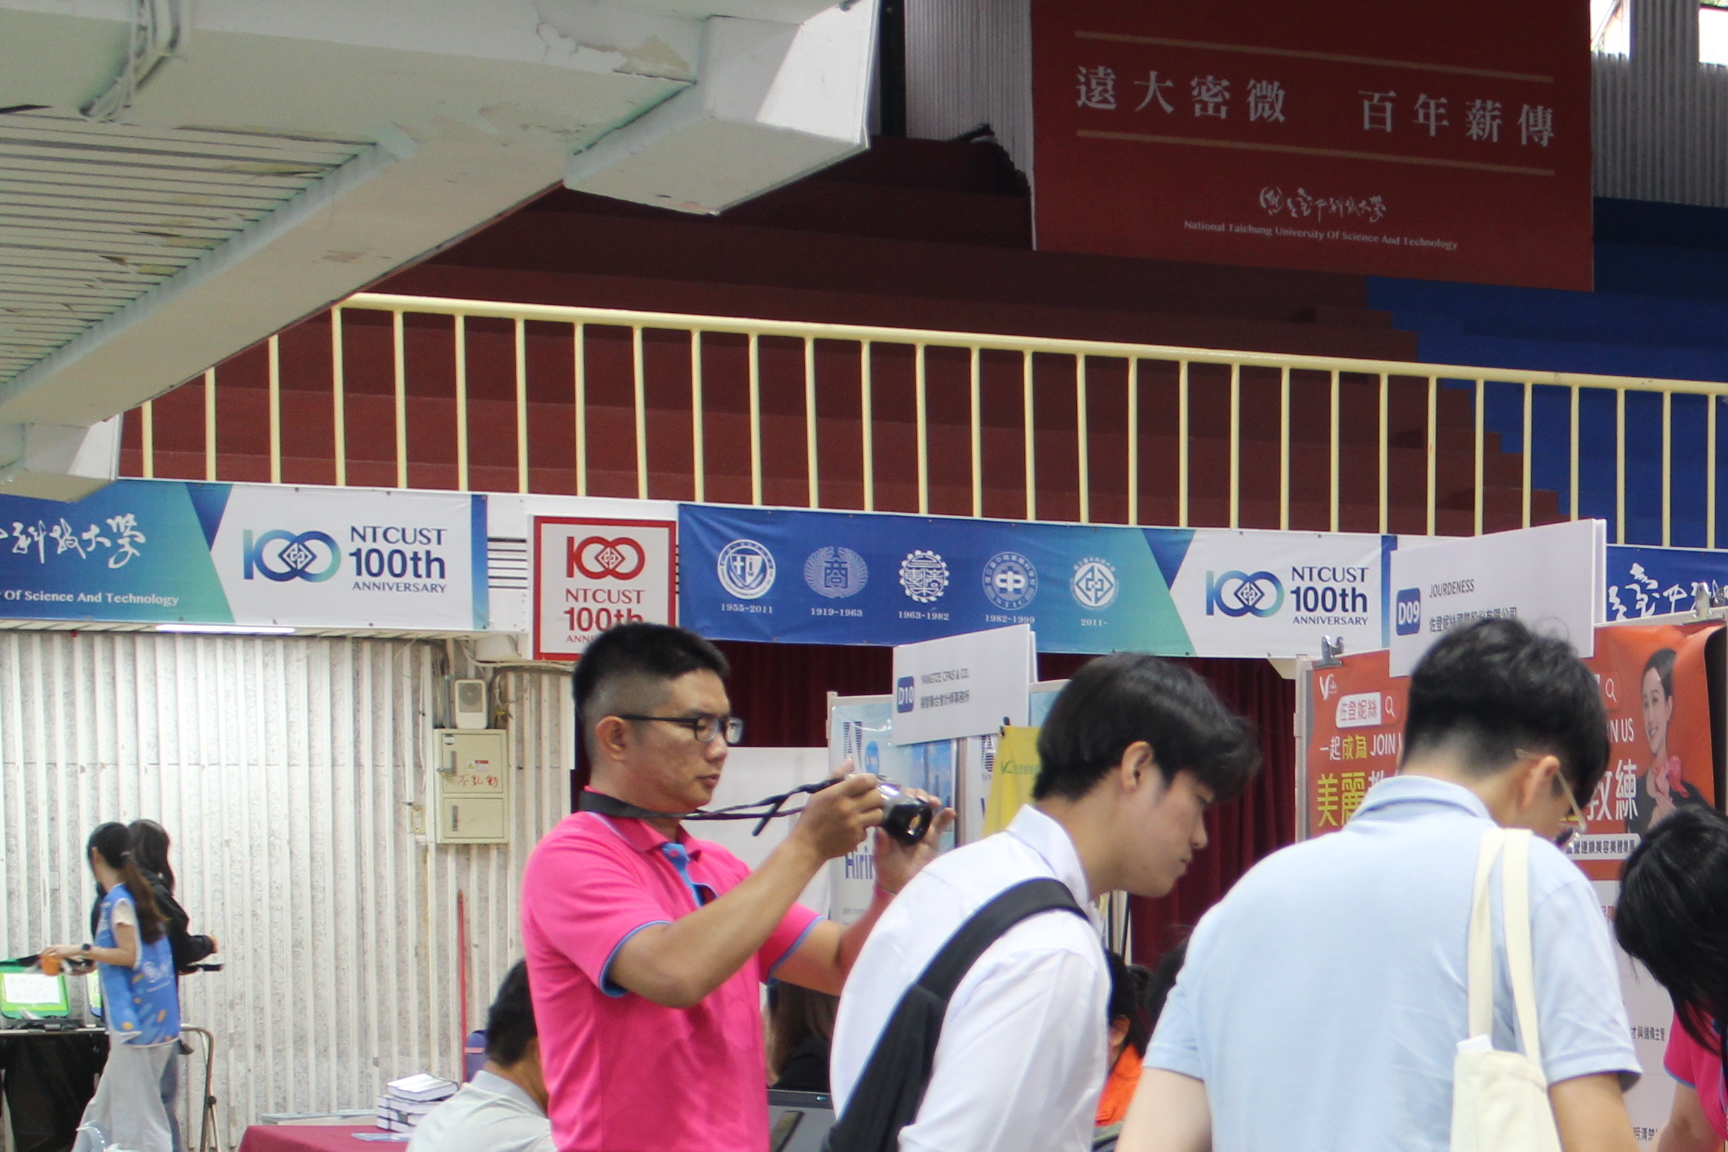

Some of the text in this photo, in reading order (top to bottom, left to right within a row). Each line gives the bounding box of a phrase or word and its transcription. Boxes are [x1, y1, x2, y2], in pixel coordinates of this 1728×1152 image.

[1075, 66, 1555, 147] 遠大密微 百年薪傳
[1184, 220, 1458, 250] National Taichung University Of Science And Technology
[350, 525, 447, 545] NTCUST
[348, 547, 445, 579] 100th
[1290, 565, 1370, 582] NTCUST
[352, 581, 447, 593] ANNIVERSARY
[565, 589, 645, 604] NTCUST
[1429, 578, 1475, 598] JOURDENESS
[4, 590, 179, 606] Of Science And Technology
[1290, 585, 1369, 612] 100th
[563, 607, 643, 632] 100th
[721, 603, 773, 614] 1955~2011
[810, 607, 863, 617] 1919~1963
[898, 611, 949, 621] 1963~1982
[985, 614, 1035, 624] 1982~1999
[1292, 615, 1370, 626] ANNIVERSARY
[1398, 601, 1420, 626] D09
[899, 686, 914, 705] D10
[1622, 717, 1635, 742] US
[1320, 735, 1368, 760] 一起成為
[1370, 733, 1396, 757] JOIN
